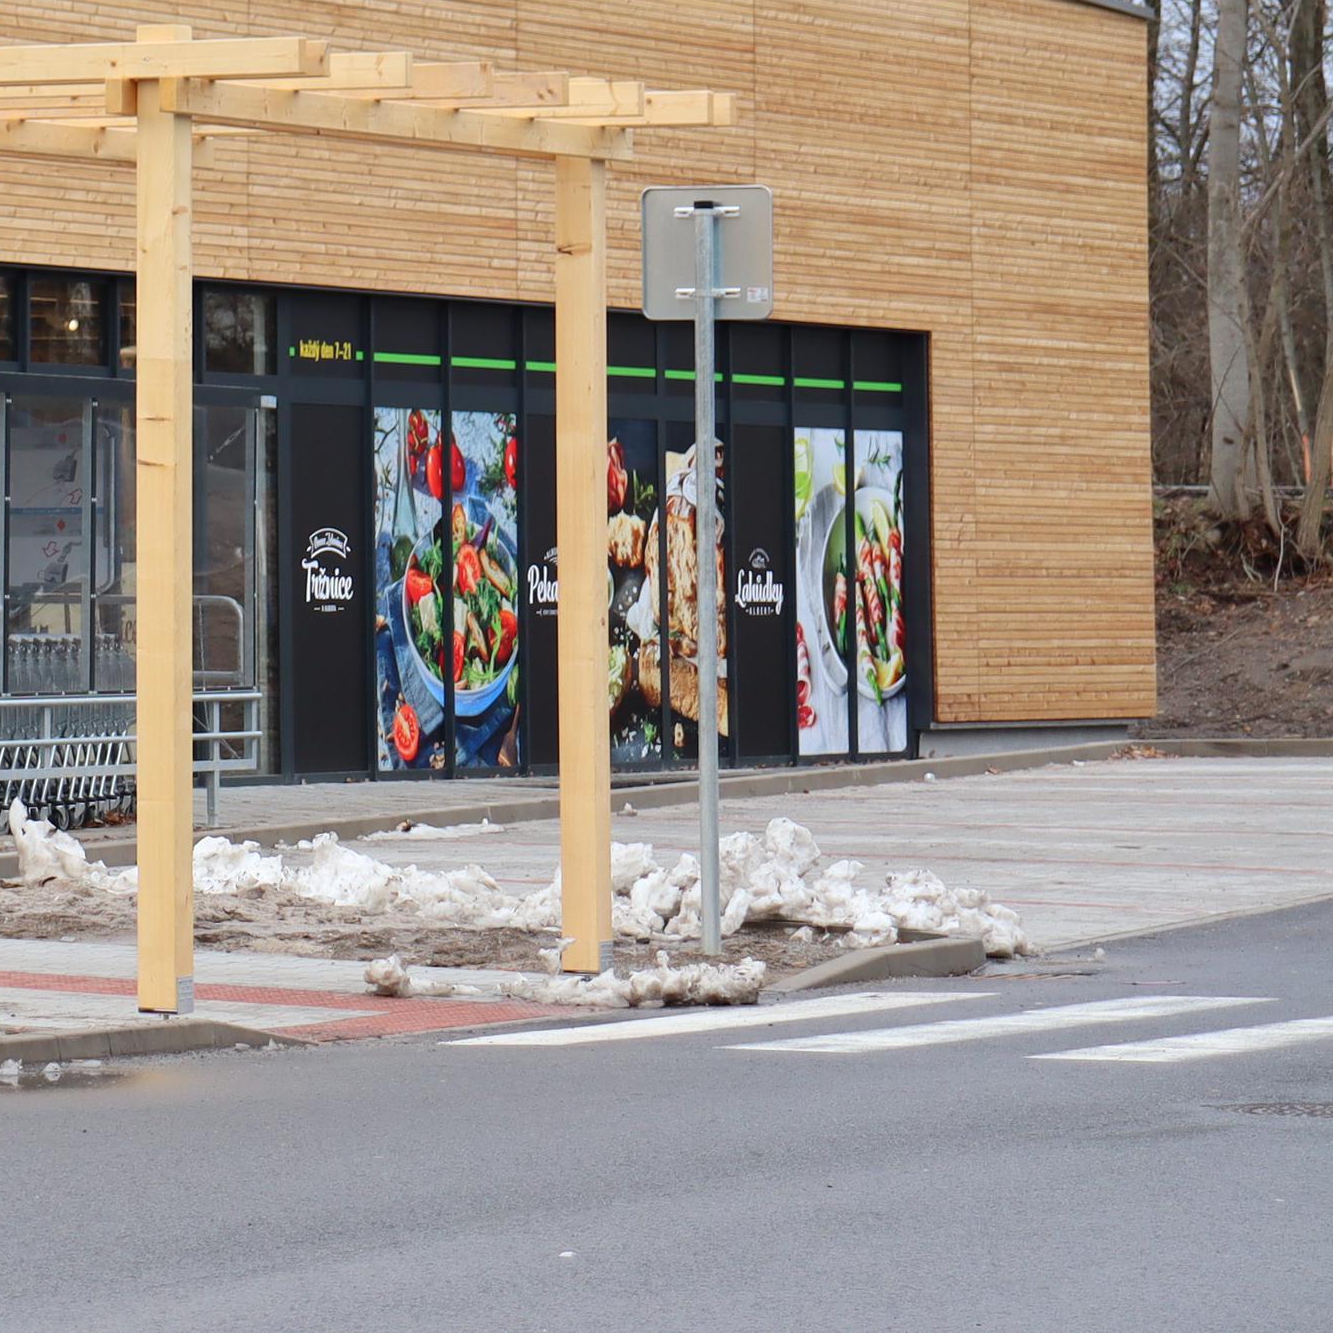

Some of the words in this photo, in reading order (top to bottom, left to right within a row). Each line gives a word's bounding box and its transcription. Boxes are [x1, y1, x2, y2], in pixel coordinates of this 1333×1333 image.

[299, 339, 319, 363] každý
[320, 340, 335, 359] den
[301, 558, 354, 603] Tržnice
[734, 568, 784, 616] Lahůdky
[749, 606, 771, 615] ALBERT
